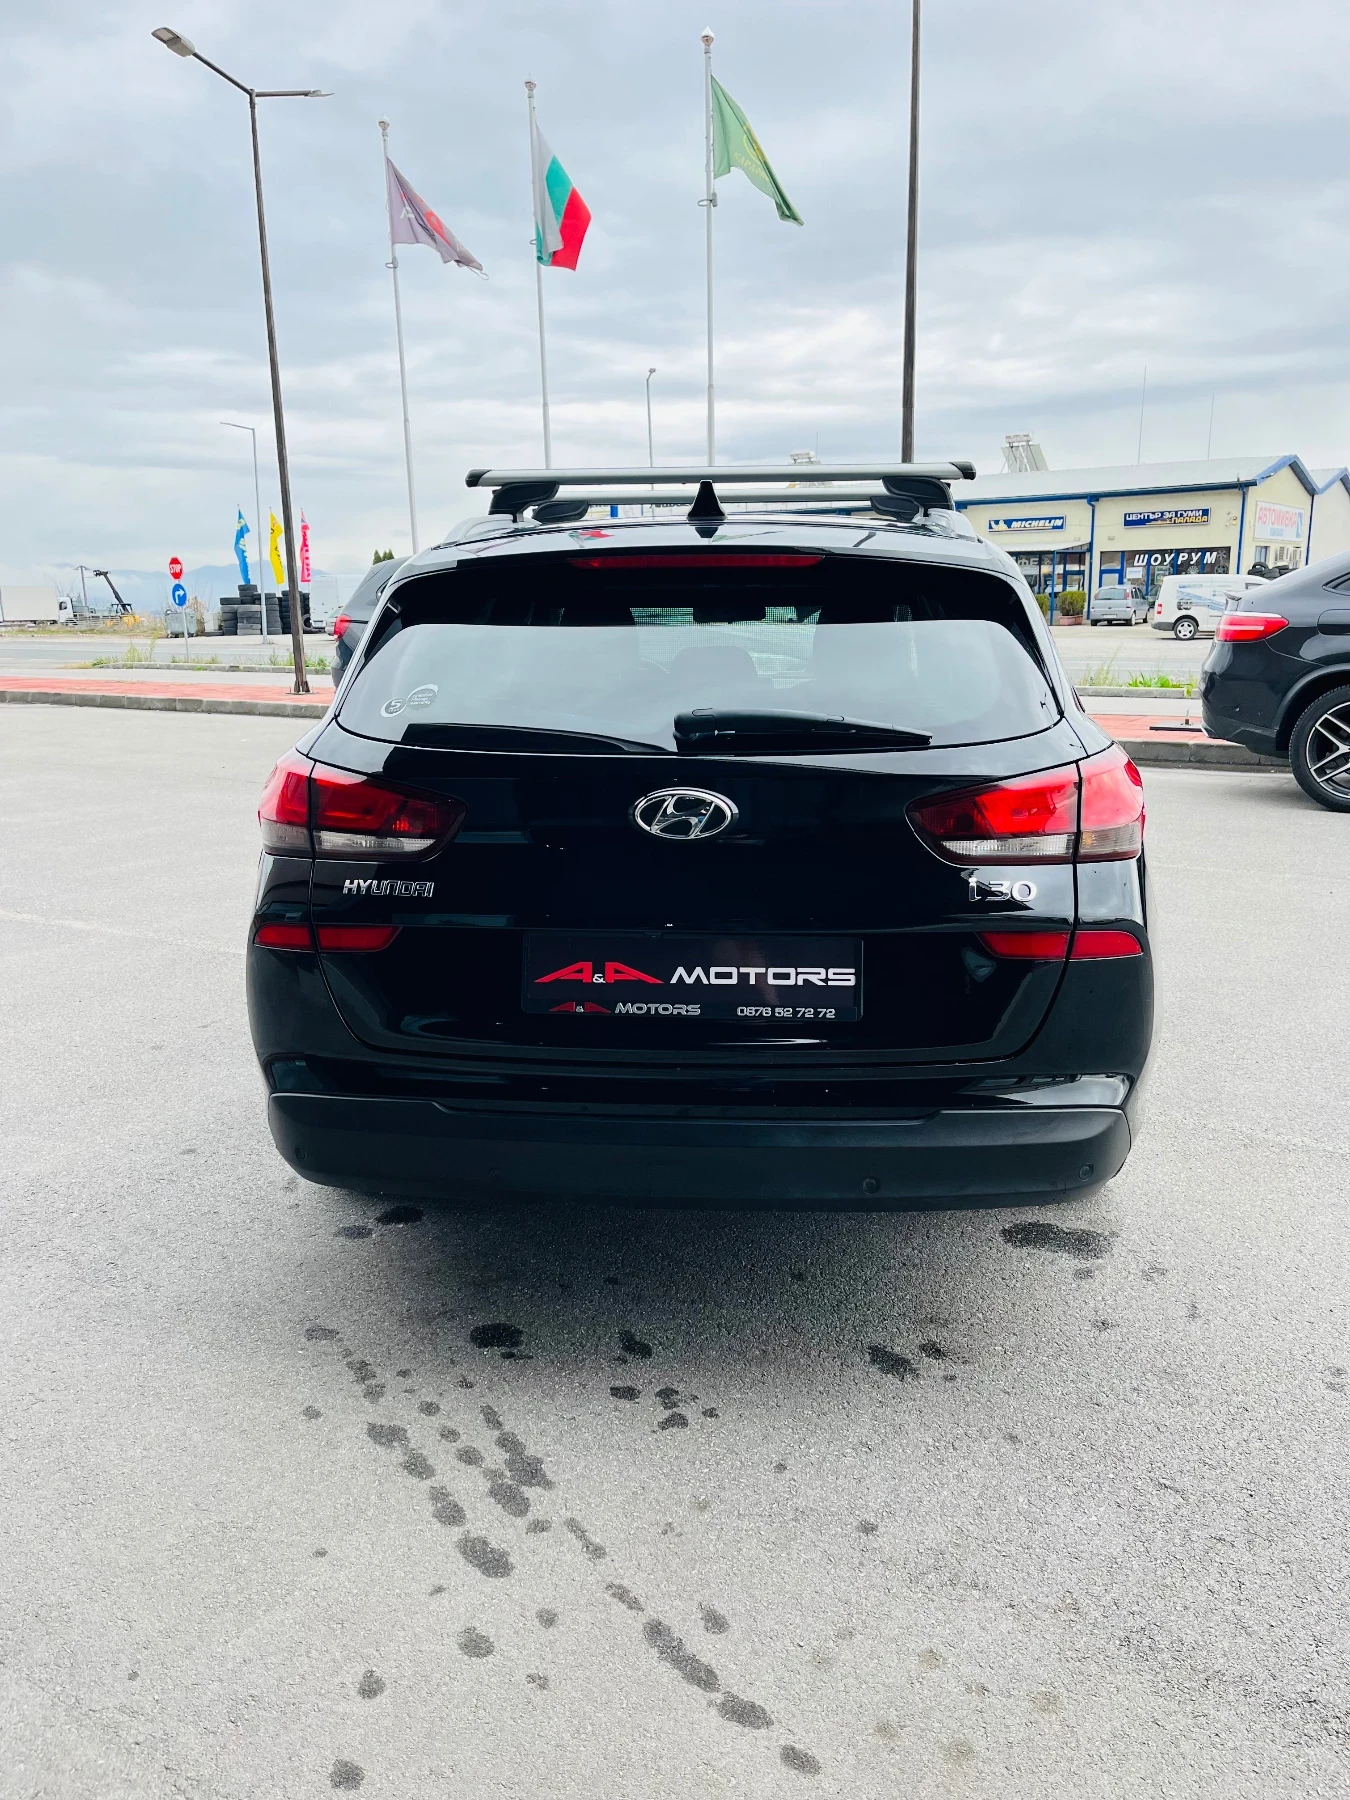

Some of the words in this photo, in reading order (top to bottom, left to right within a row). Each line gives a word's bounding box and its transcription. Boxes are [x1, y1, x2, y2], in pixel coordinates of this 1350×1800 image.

[1125, 512, 1161, 521] ЦЕНТЪР
[1163, 511, 1175, 519] ЗА
[1177, 509, 1203, 518] ГУМИ
[1257, 506, 1297, 528] АВТОМИВКА
[1010, 518, 1064, 529] MICHELIN
[1133, 551, 1218, 567] ШОУРУМ
[169, 563, 182, 574] STOP
[342, 879, 435, 898] HYUNDAI
[968, 876, 1038, 902] i30
[533, 961, 665, 984] A&A
[669, 966, 856, 986] MOTORS
[548, 1001, 612, 1014] A&A
[614, 1002, 701, 1016] MOTORS
[736, 1006, 772, 1017] 0876
[774, 1006, 793, 1017] 52
[795, 1007, 814, 1018] 72
[817, 1008, 836, 1019] 72
